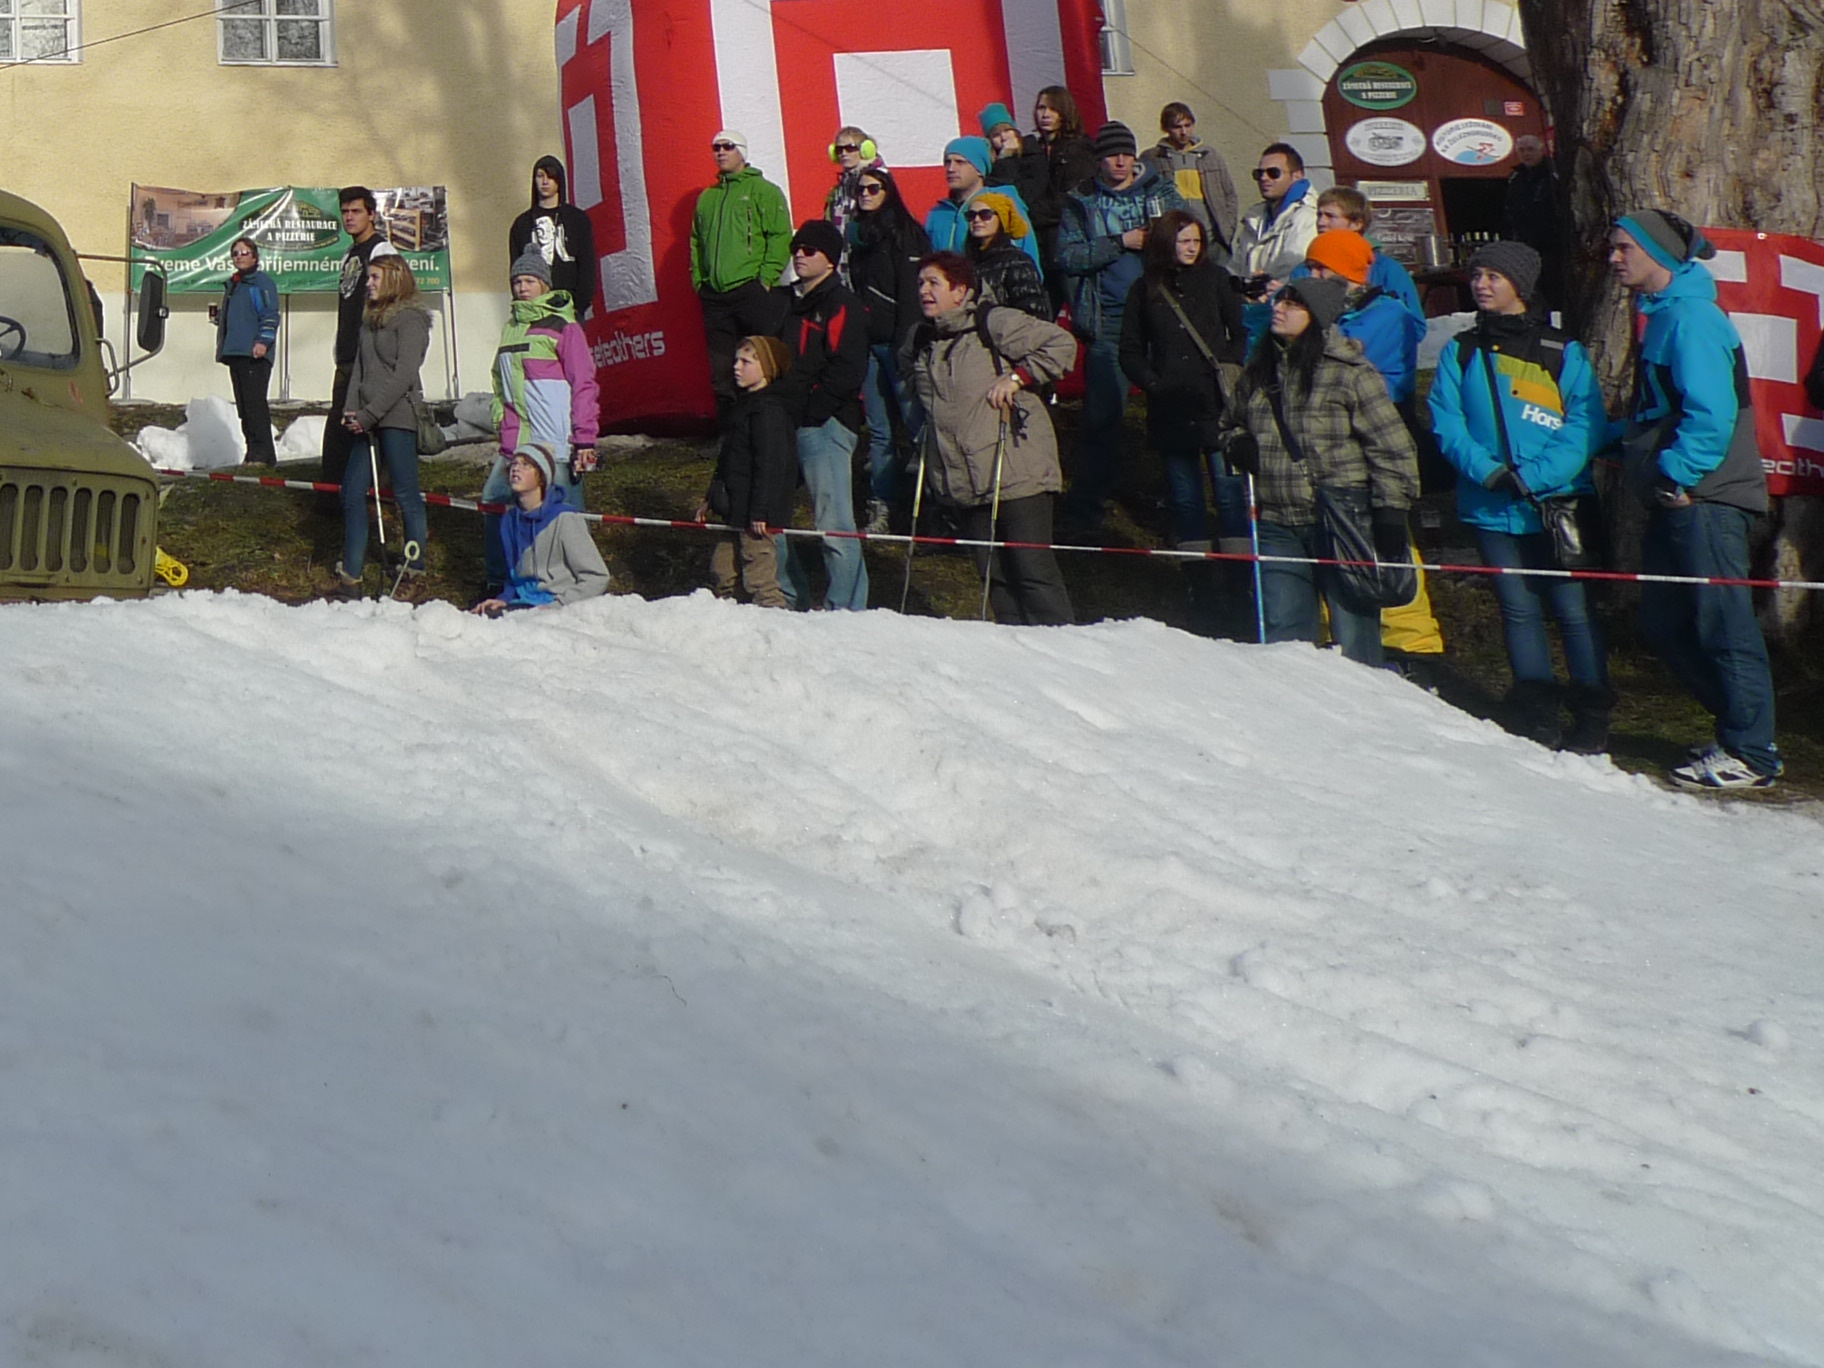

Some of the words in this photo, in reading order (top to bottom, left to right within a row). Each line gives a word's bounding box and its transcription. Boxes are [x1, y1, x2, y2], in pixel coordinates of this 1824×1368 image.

[284, 220, 338, 230] RESTAURACE
[266, 232, 273, 241] A
[275, 232, 316, 241] PIZZERIE
[1521, 403, 1563, 430] Hors
